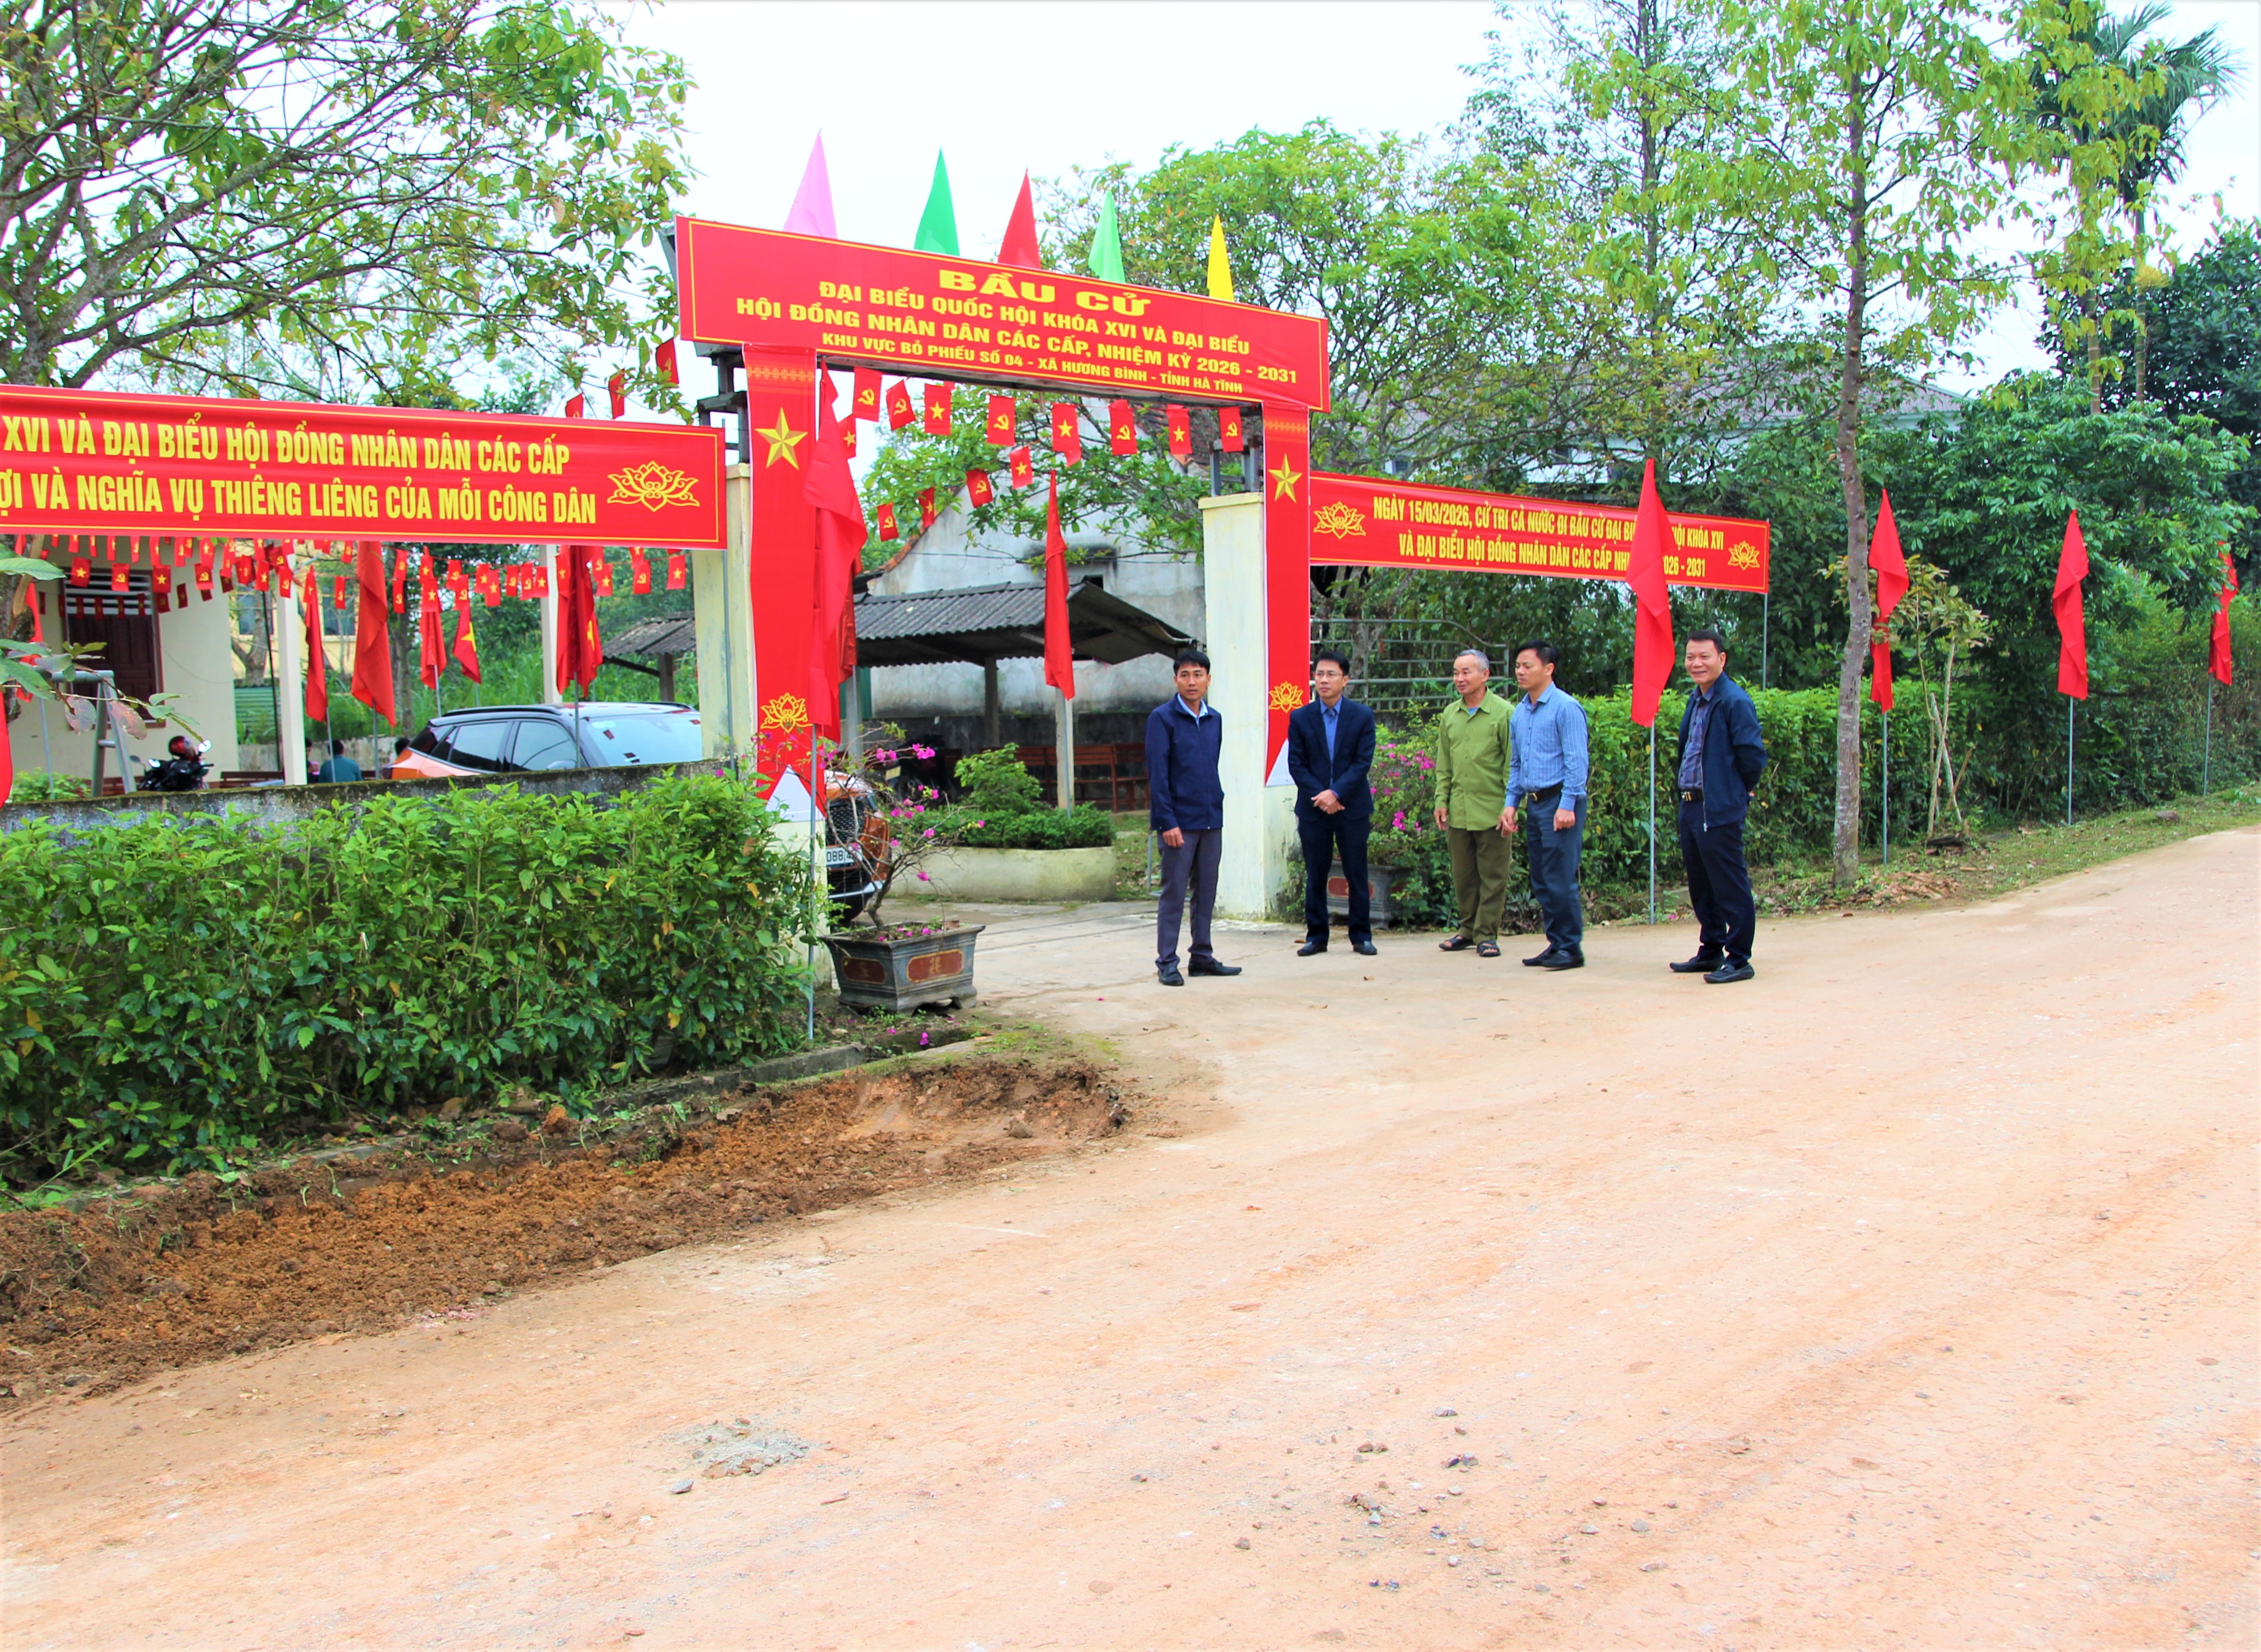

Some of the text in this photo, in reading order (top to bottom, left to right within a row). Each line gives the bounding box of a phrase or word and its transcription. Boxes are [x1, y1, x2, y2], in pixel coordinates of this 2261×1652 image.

[818, 281, 1249, 355] ĐẠI BIỂU QUỐC HỘI KHÓA XVI VÀ ĐẠI BIỂU
[939, 269, 1151, 317] BẦU CỬ
[737, 297, 781, 320] HỘI
[789, 302, 860, 328] ĐỒNG
[867, 314, 936, 337] NHÂN
[943, 322, 990, 343] DÂN
[997, 330, 1040, 349] CÁC
[1047, 335, 1091, 358] CẤP,
[1097, 343, 1162, 366] NHIỆM
[1168, 346, 1192, 369] KỲ
[1197, 357, 1240, 376] 2026
[1258, 366, 1296, 383] 2031
[822, 332, 857, 348] KHU
[862, 337, 895, 353] VỰC
[900, 340, 923, 356] BỎ
[928, 345, 975, 361] PHIẾU
[980, 349, 1000, 364] SỐ
[1004, 354, 1023, 367] 04
[1038, 357, 1058, 371] XÃ
[1062, 361, 1110, 377] HƯƠNG
[1114, 366, 1147, 382] BÌNH
[1160, 371, 1190, 387] TỈNH
[1193, 377, 1211, 389] HÀ
[1213, 379, 1243, 393] TĨNH
[2, 412, 570, 475] XVI VÀ ĐẠI BIỂU HỘI ĐỒNG NHÂN DÂN CÁC CẤP
[31, 466, 70, 510] VÀ
[77, 470, 163, 512] NGHĨA
[169, 478, 203, 521] VỤ
[210, 474, 302, 516] THIÊNG
[309, 477, 378, 518] LIÊNG
[385, 476, 432, 519] CỦA
[438, 477, 482, 521] MỖI
[488, 484, 547, 523] CÔNG
[553, 487, 596, 524] DÂN
[1374, 493, 1405, 521] NGÀY
[1408, 500, 1472, 529] 15/03/2026,
[1475, 500, 1492, 528] CỬ
[1492, 508, 1509, 530] TRI
[1511, 504, 1525, 532] CẢ
[1527, 509, 1555, 534] NƯỚC
[1556, 515, 1568, 535] ĐI
[1569, 510, 1590, 537] BẦU
[1591, 513, 1606, 539] CỬ
[1606, 519, 1622, 544] ĐẠI
[1687, 525, 1709, 549] KHÓA
[1710, 531, 1724, 550] XVI
[1399, 529, 1414, 556] VÀ
[1417, 535, 1436, 562] ĐẠI
[1439, 529, 1464, 560] BIỂU
[1467, 535, 1485, 565] HỘI
[1487, 534, 1516, 563] ĐỒNG
[1519, 540, 1547, 565] NHÂN
[1549, 542, 1569, 567] DÂN
[1572, 544, 1591, 569] CÁC
[1594, 543, 1612, 570] CẤP
[1663, 555, 1679, 575] 026
[1686, 557, 1705, 577] 2031
